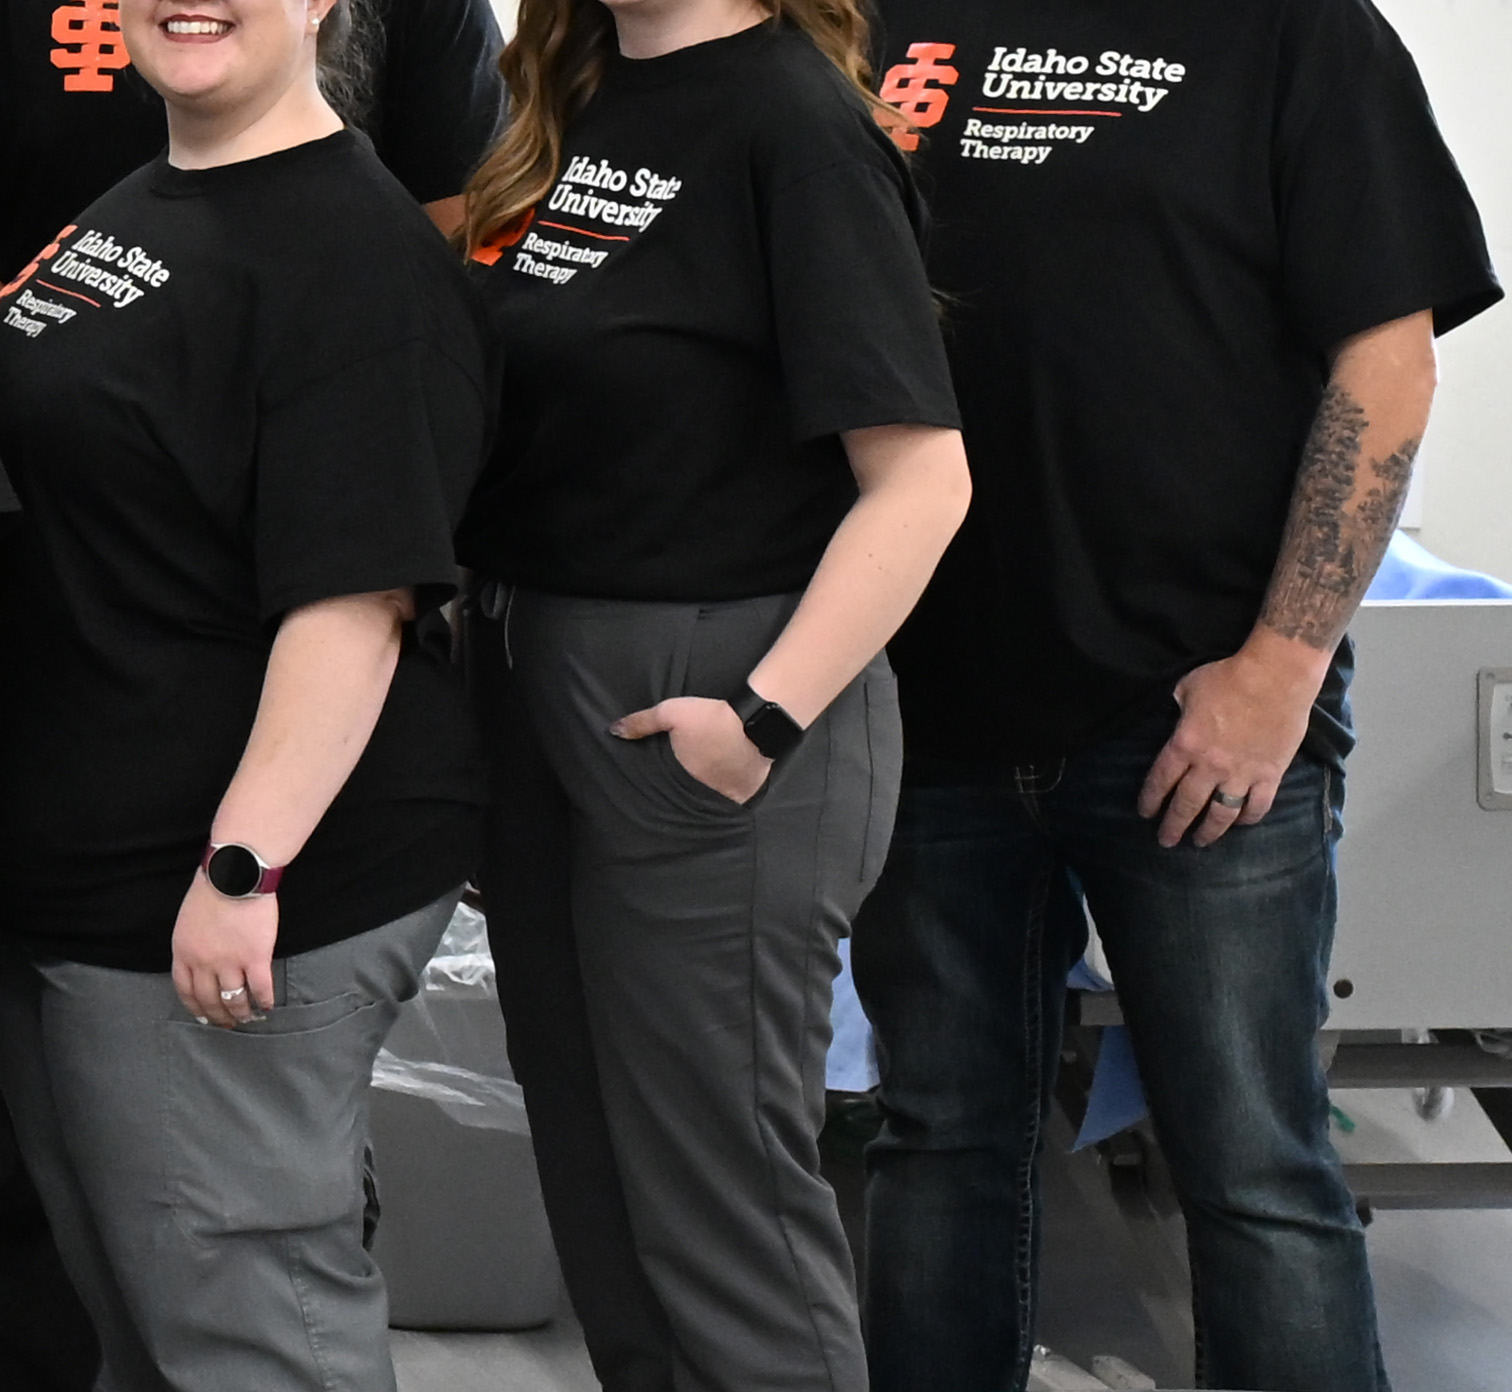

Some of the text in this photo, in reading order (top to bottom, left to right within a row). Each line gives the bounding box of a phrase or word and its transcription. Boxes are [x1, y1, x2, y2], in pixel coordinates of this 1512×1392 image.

[987, 46, 1186, 83] Idaho State
[982, 72, 1169, 112] University
[964, 119, 1095, 144] Respiratory
[960, 139, 1052, 164] Therapy
[561, 156, 628, 191] Idaho
[548, 184, 663, 233] University
[71, 230, 123, 262] Idaho
[117, 246, 170, 288] State
[522, 232, 609, 268] Respiratory
[51, 250, 145, 308] University
[513, 253, 577, 284] Therapy
